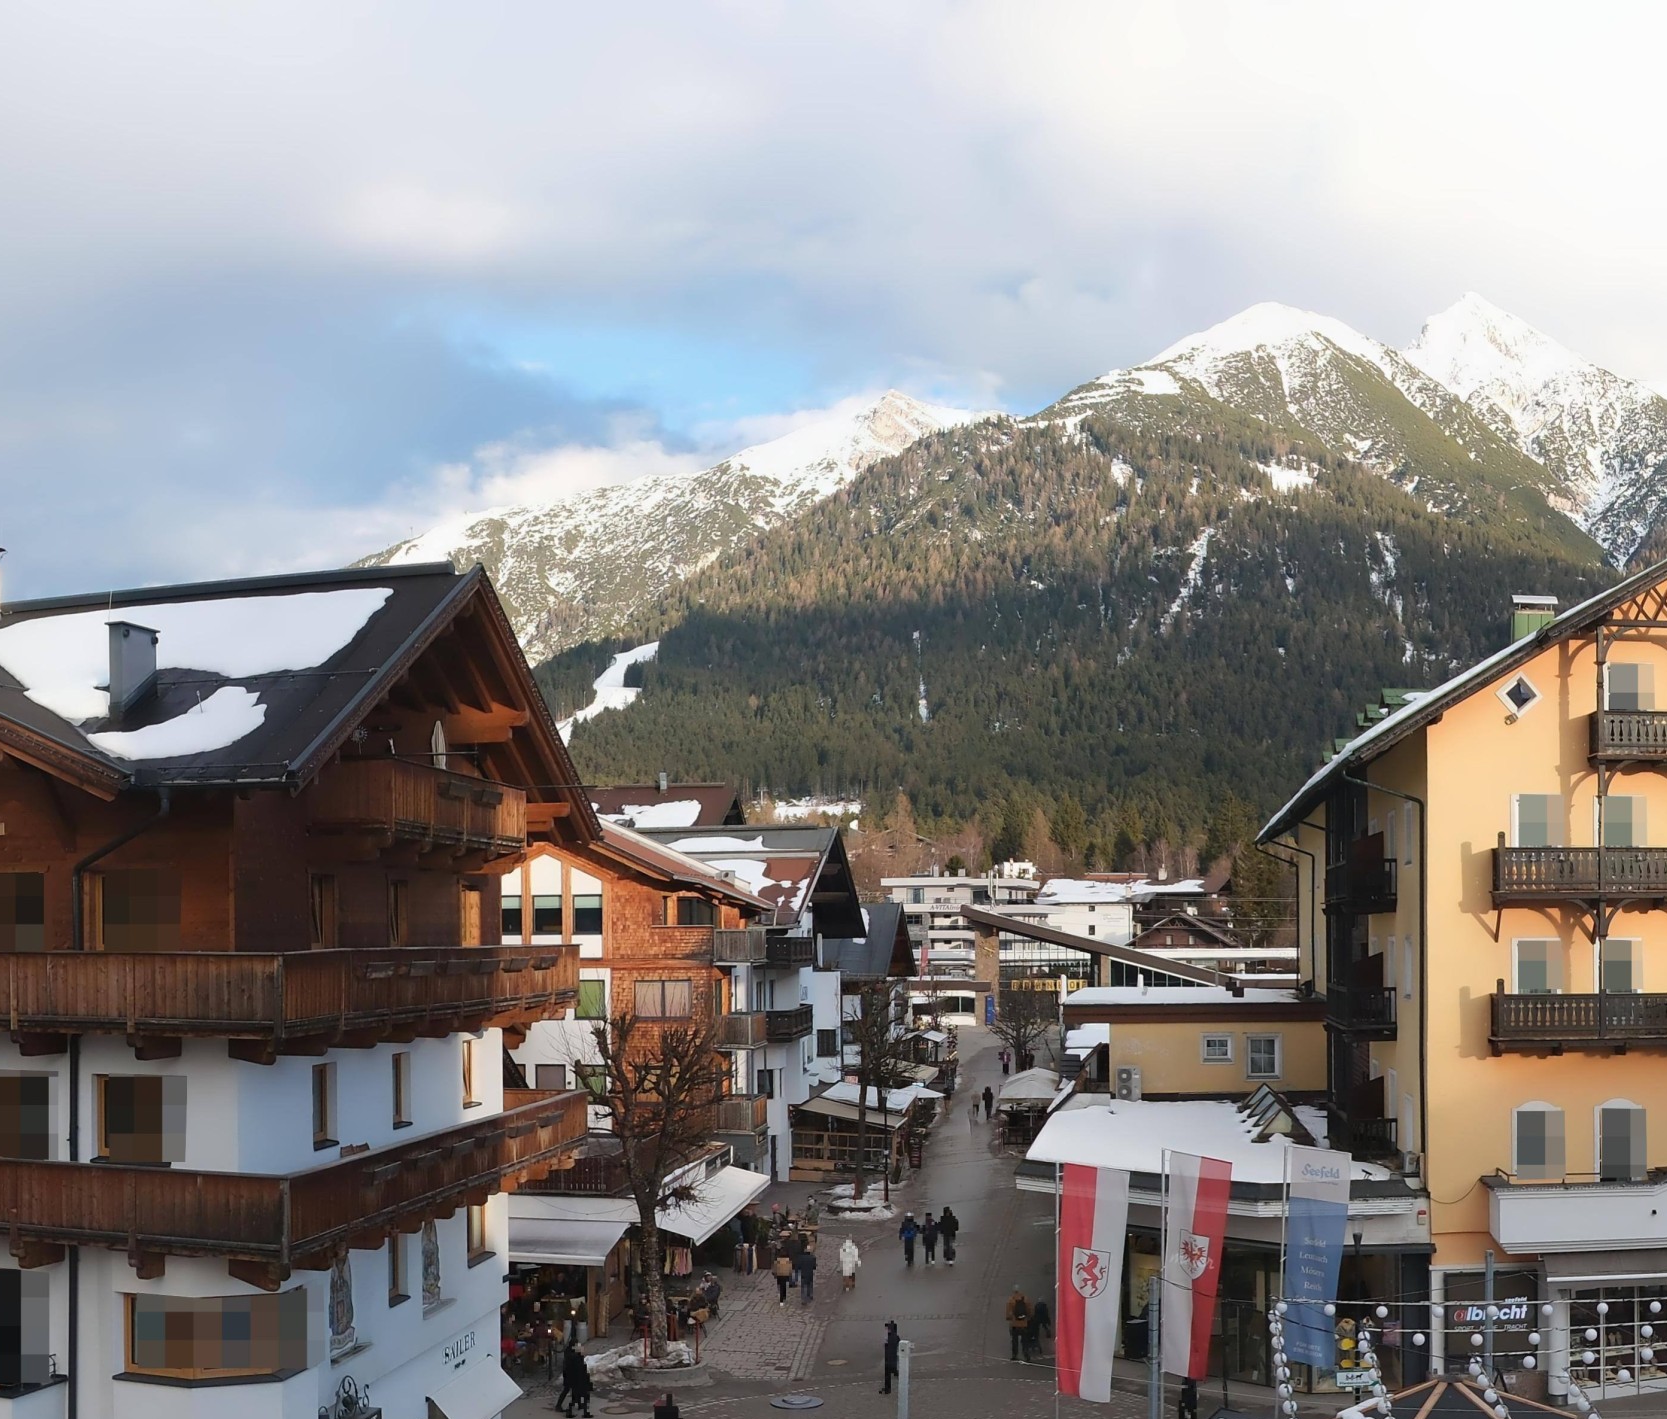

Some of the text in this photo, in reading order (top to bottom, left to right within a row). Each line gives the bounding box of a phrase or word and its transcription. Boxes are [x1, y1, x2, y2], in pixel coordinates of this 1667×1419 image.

[1301, 1163, 1340, 1179] Seefeld
[1454, 1305, 1528, 1322] albcht
[443, 1331, 476, 1365] SAILER
